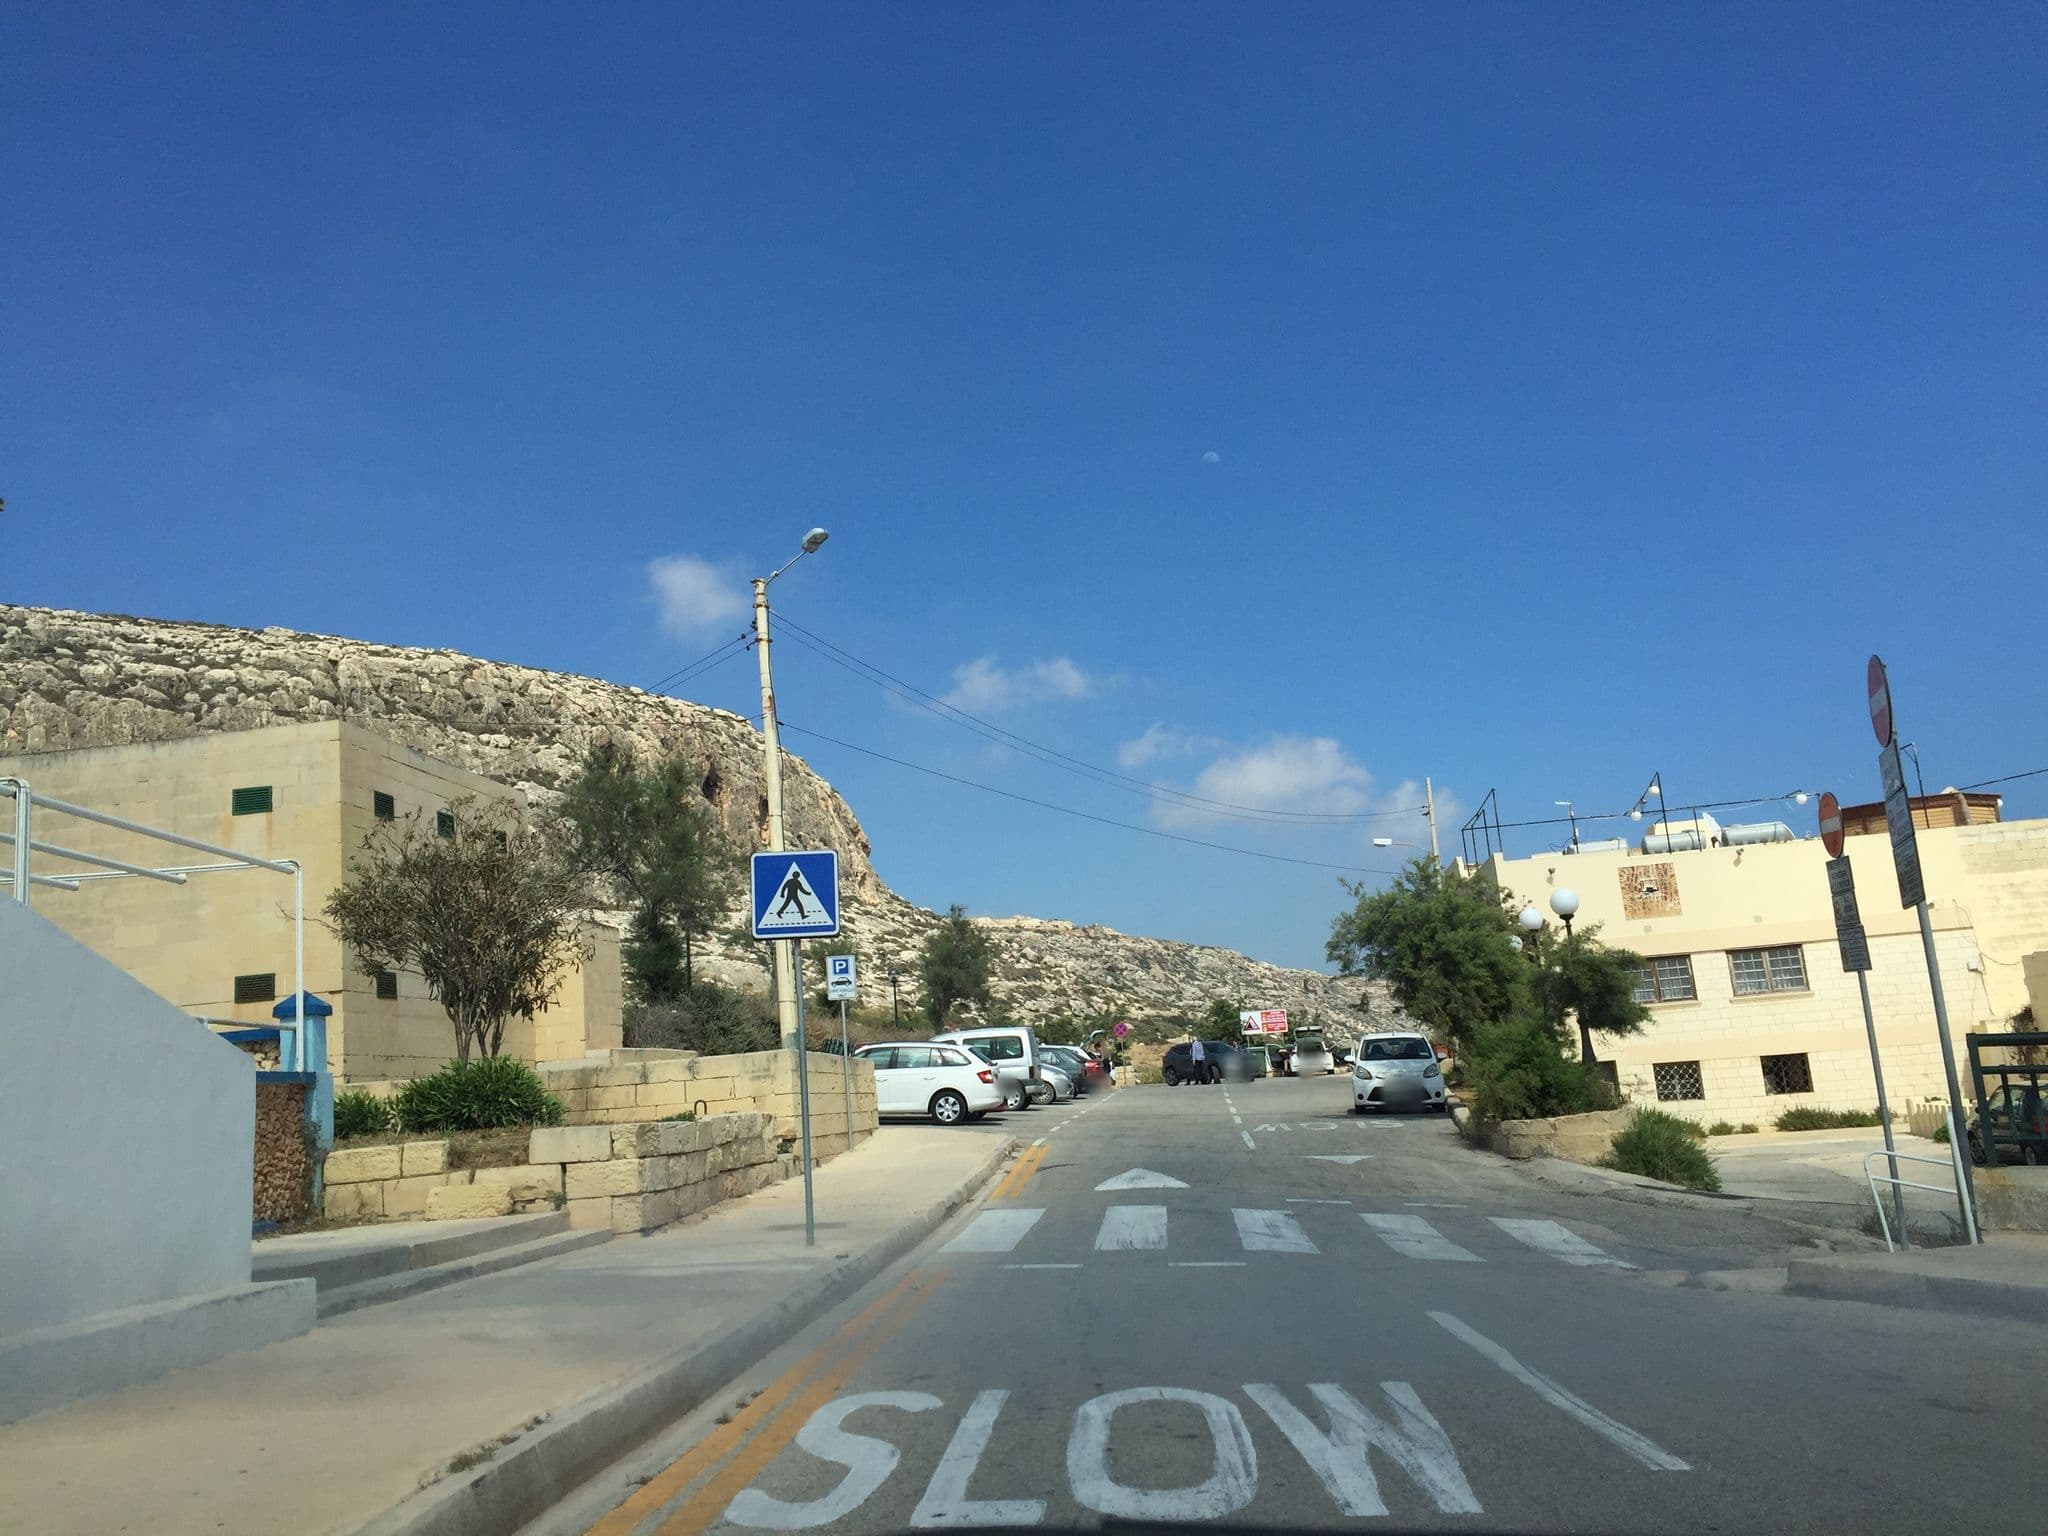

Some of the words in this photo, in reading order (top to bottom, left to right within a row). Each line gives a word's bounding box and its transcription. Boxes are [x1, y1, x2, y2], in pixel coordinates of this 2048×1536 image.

[836, 961, 847, 973] P
[1254, 1119, 1405, 1132] SLOW
[724, 1382, 1484, 1528] SLOW
